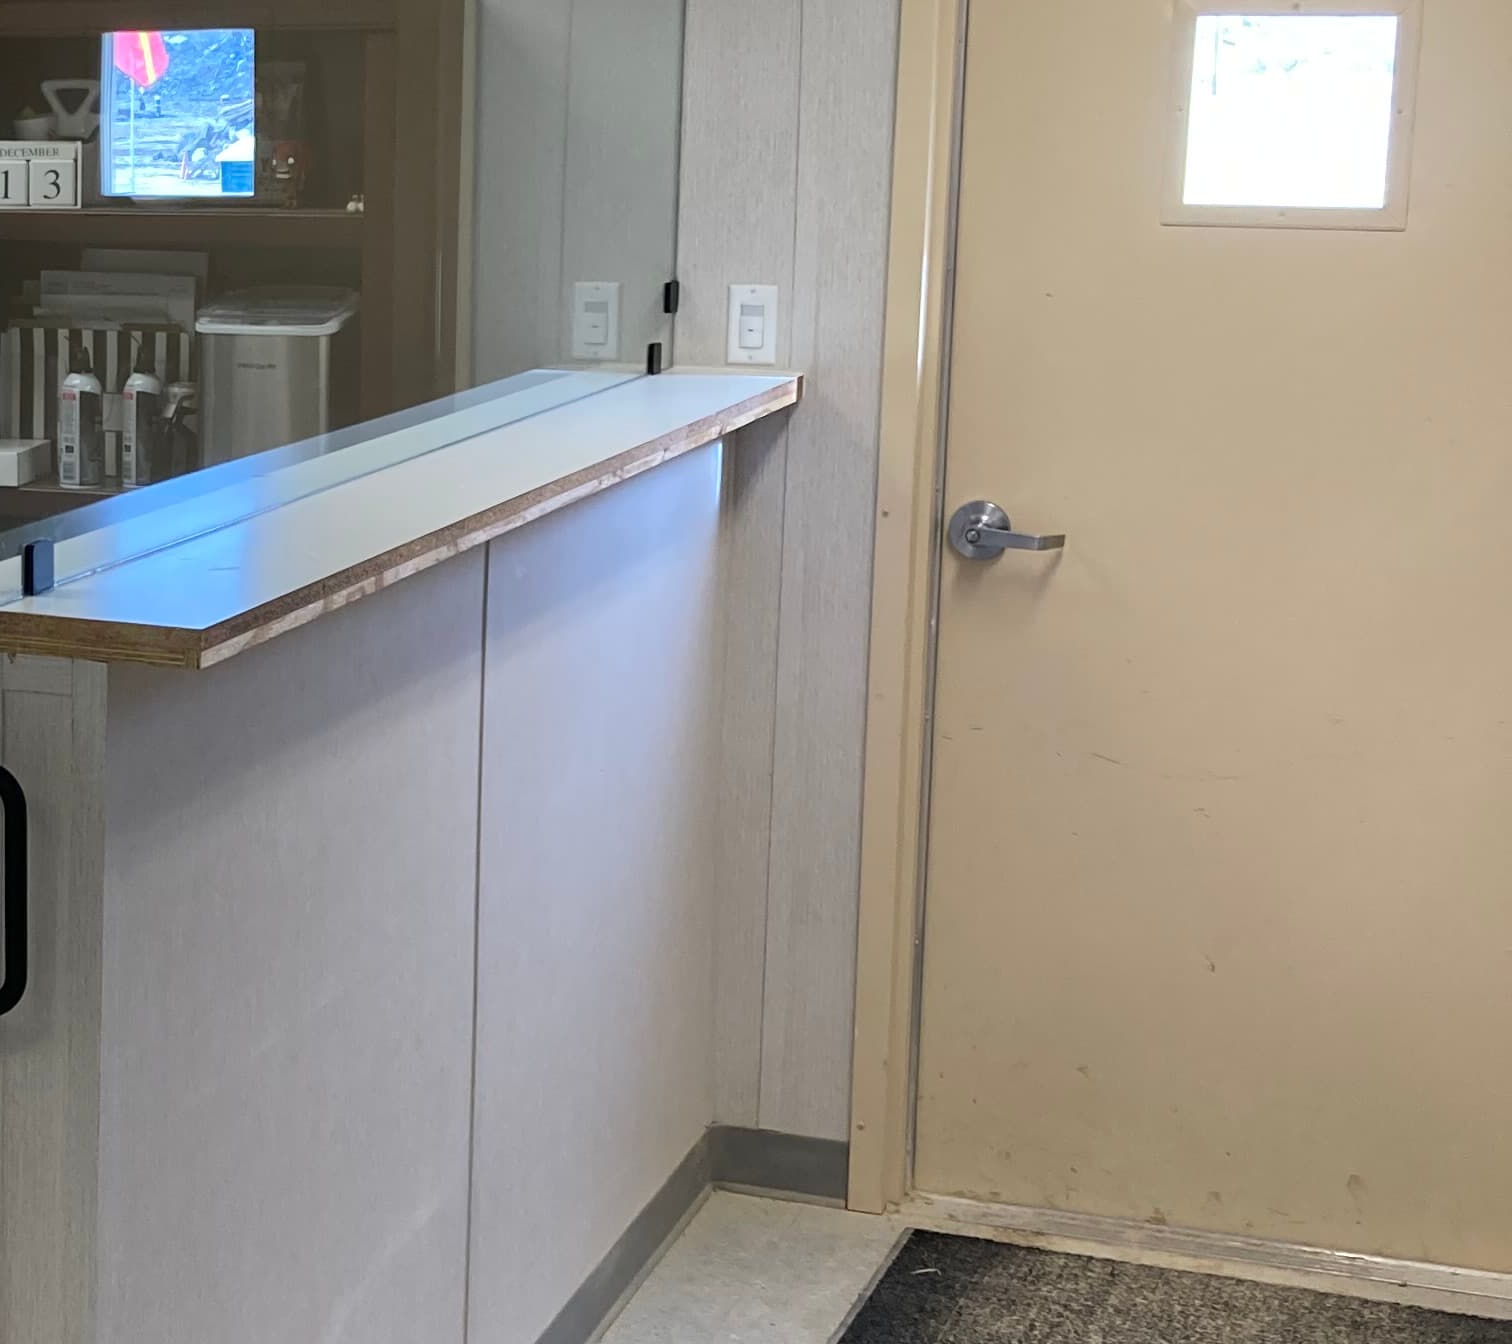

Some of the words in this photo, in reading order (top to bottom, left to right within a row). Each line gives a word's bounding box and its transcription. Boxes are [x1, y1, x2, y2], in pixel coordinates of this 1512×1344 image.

[0, 147, 59, 158] DECEMBER
[0, 170, 12, 199] 1
[43, 169, 61, 199] 3
